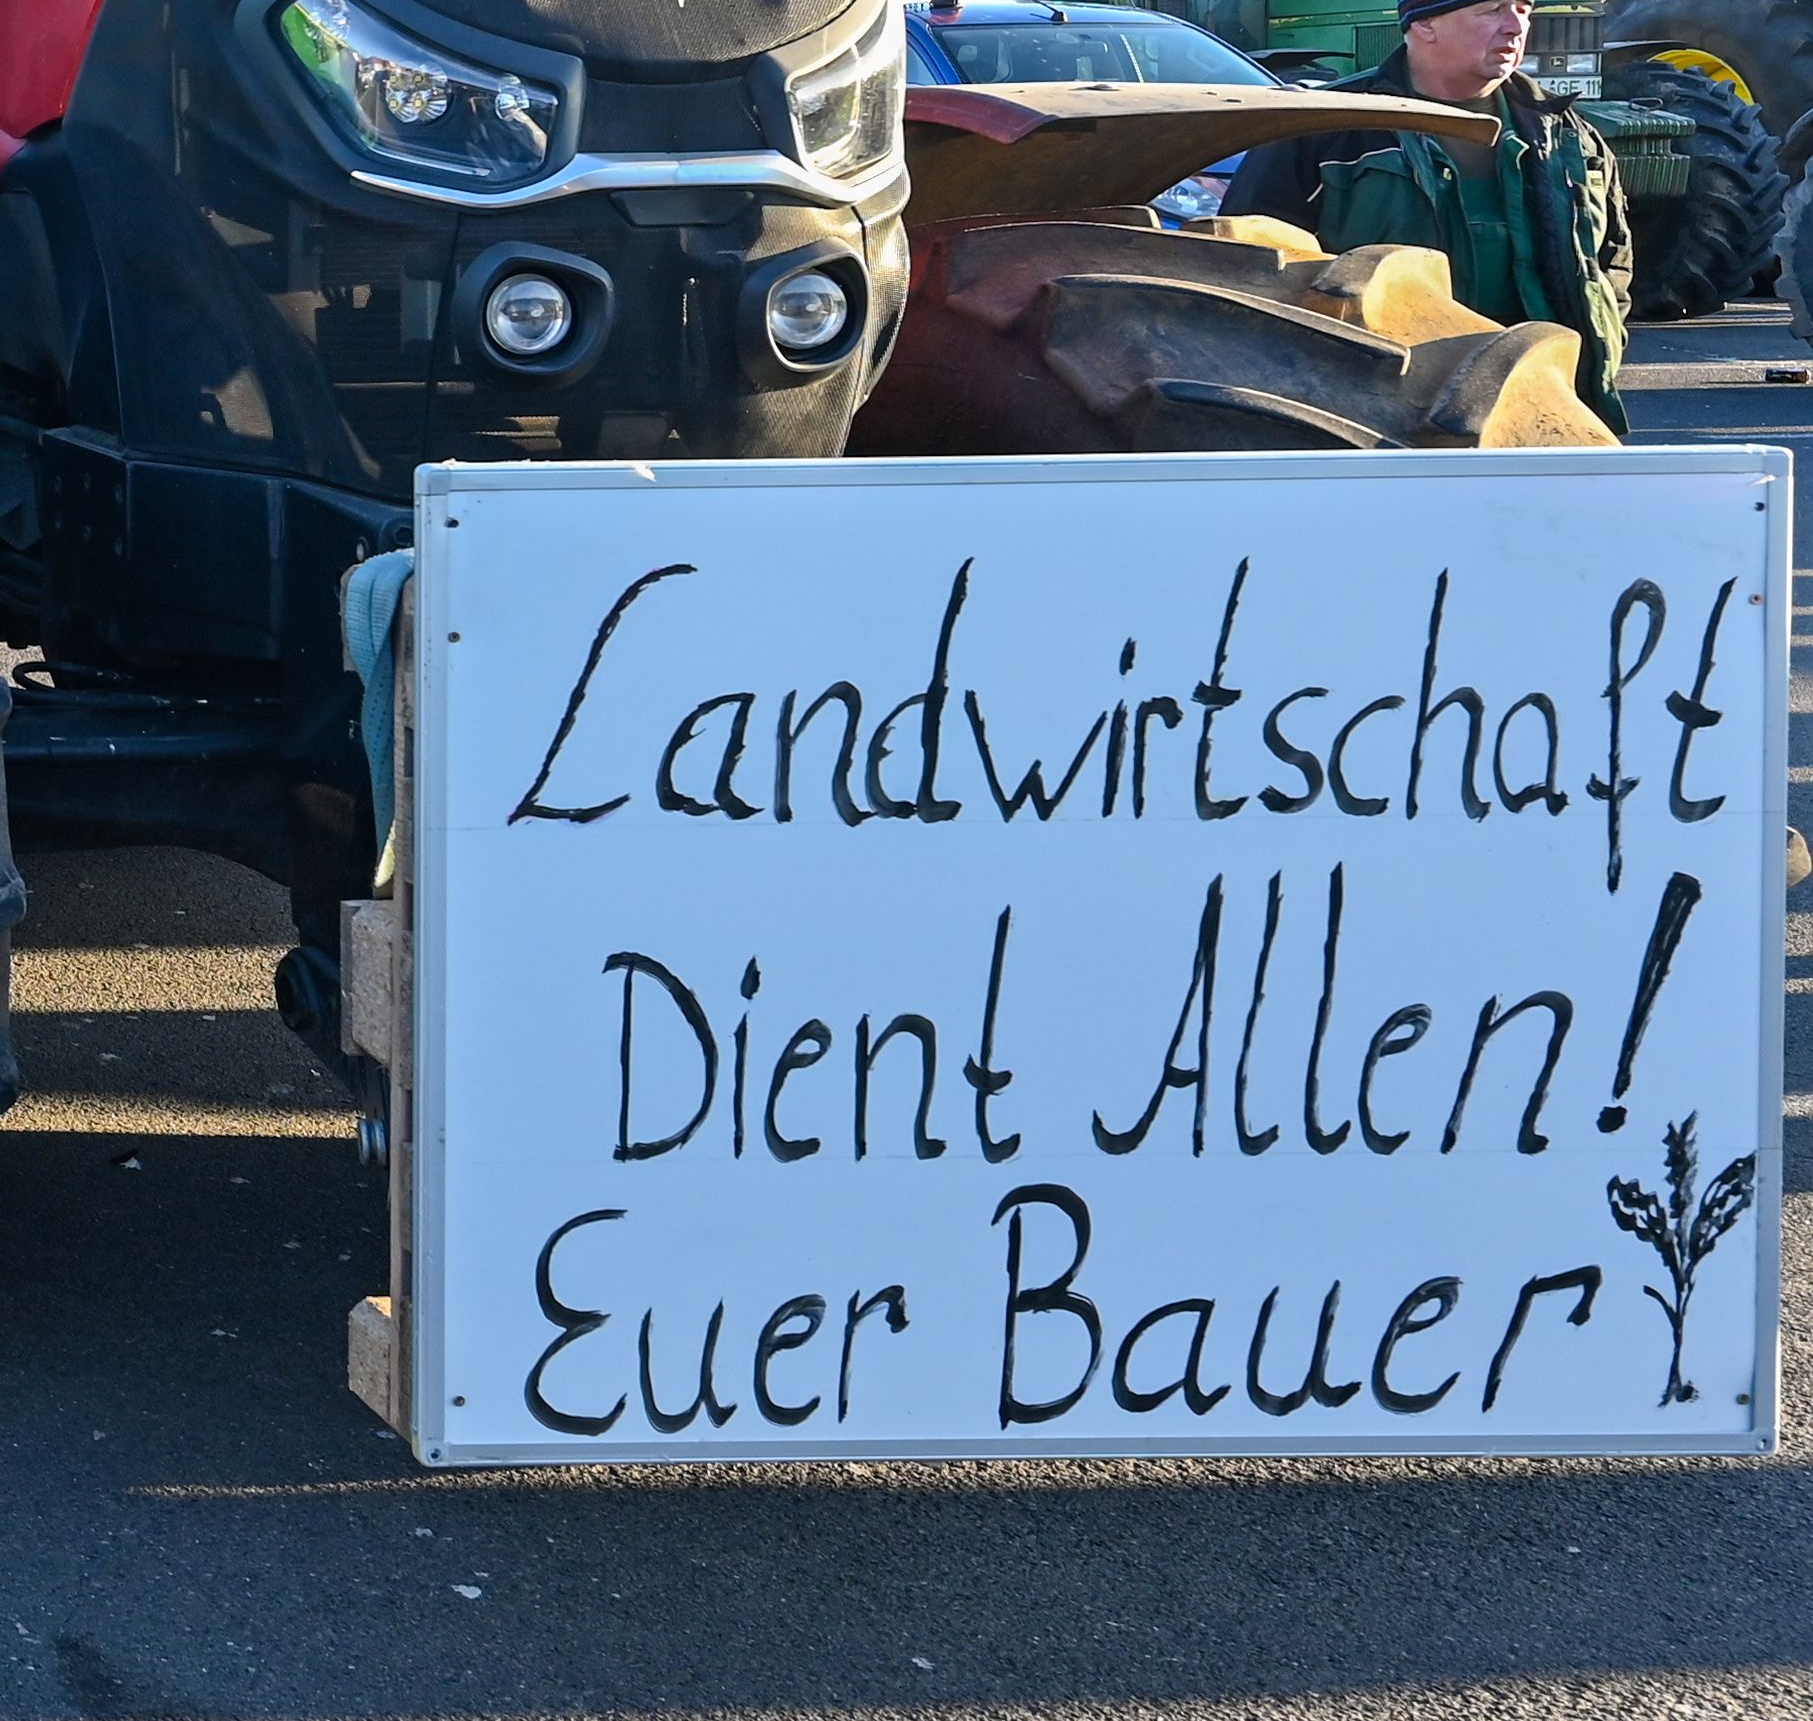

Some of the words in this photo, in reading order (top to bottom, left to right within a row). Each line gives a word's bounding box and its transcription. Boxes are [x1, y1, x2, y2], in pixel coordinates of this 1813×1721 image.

[507, 555, 1738, 893] Landwirtschaft
[603, 905, 1022, 1163] Dient
[1091, 862, 1703, 1159] Allen!
[524, 1209, 907, 1435] Euer
[991, 1184, 1602, 1429] Bauer
